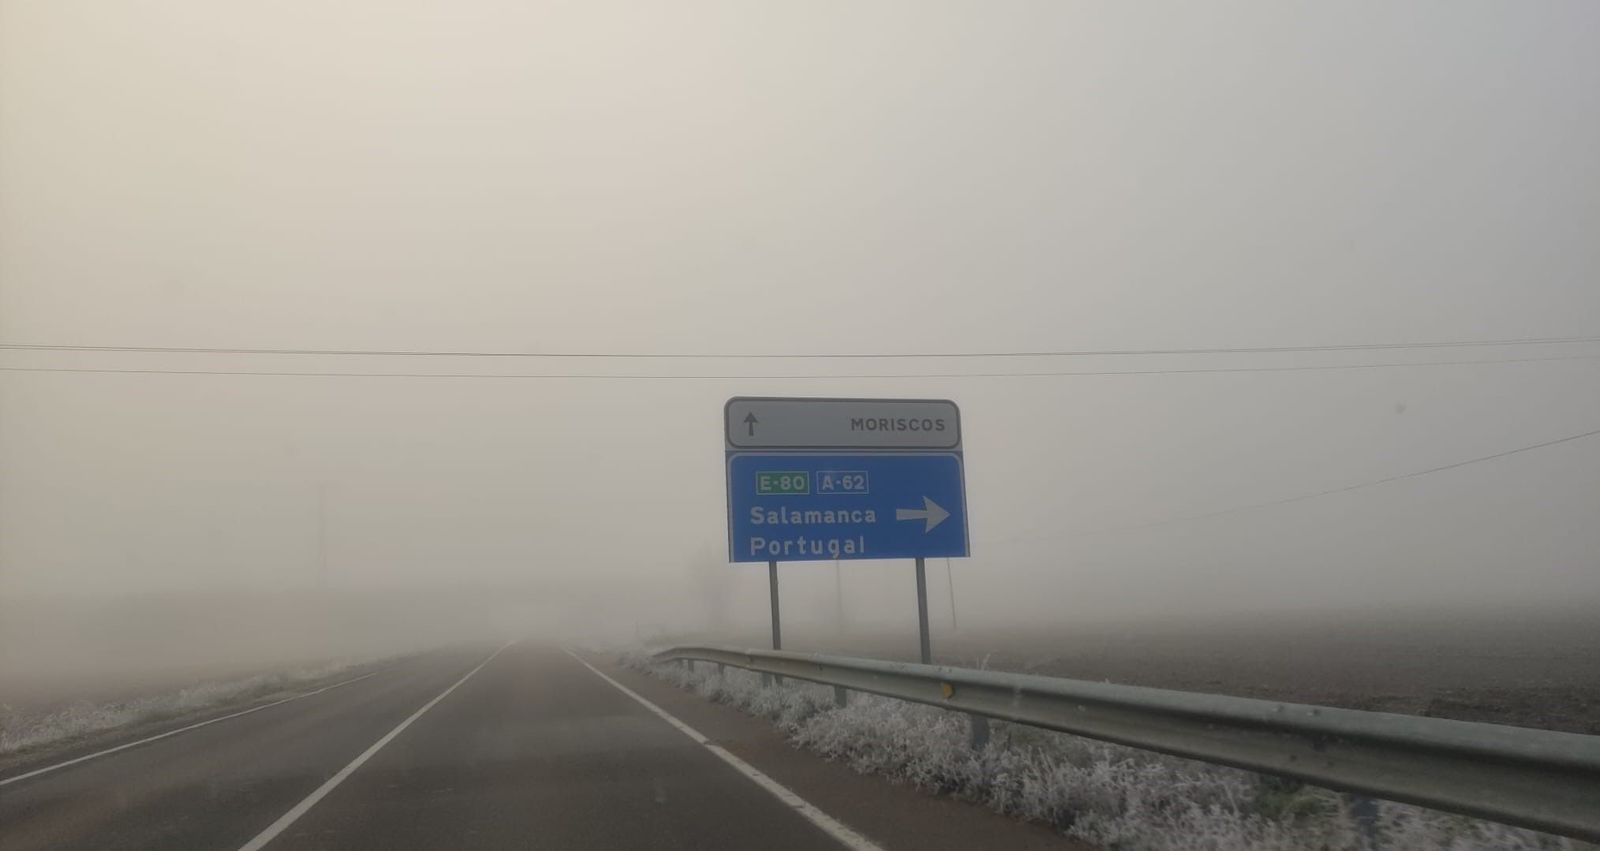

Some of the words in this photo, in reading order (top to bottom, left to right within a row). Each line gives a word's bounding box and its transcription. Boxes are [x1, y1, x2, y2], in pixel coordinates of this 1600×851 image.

[850, 418, 946, 431] MORISCOS
[759, 475, 805, 491] E-80
[821, 475, 865, 490] A-62
[750, 506, 877, 524] Salamanca
[750, 536, 865, 559] Portugal
